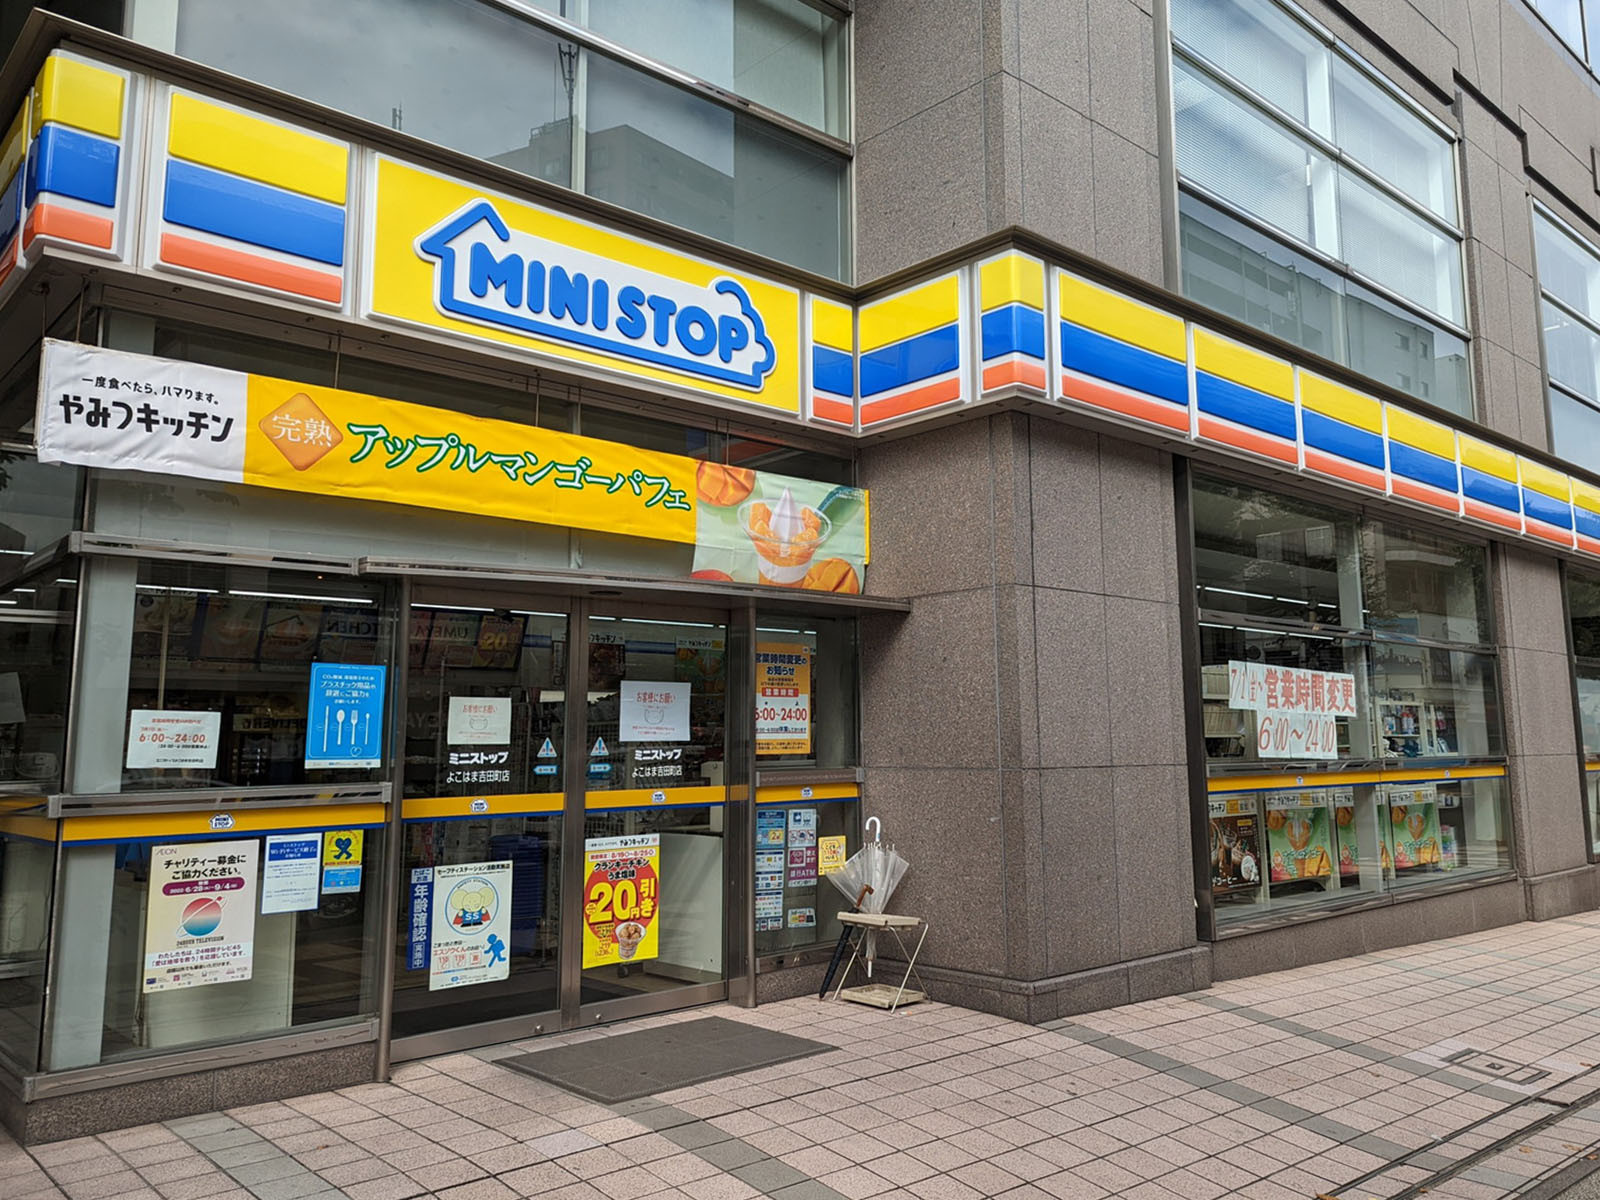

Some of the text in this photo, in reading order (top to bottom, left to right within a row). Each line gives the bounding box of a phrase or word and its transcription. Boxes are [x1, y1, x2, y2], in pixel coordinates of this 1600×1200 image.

[81, 375, 220, 405] 一度食べたら、ハマります。
[59, 393, 234, 442] やみつキッチン
[271, 414, 333, 448] 完熟
[347, 422, 691, 512] アップルマンゴーパフェ
[767, 666, 795, 676] お知らせ
[449, 751, 509, 765] ミニストップ
[634, 749, 682, 761] ミニストップ
[446, 770, 510, 784] よこはま吉田町店
[632, 765, 682, 778] よこはま吉田町店
[164, 855, 247, 869] チャリティー募金に
[594, 858, 650, 870] クランキーチキン
[171, 867, 241, 880] ご協力ください。
[412, 884, 428, 942] 年齢確認
[465, 912, 480, 921] SS
